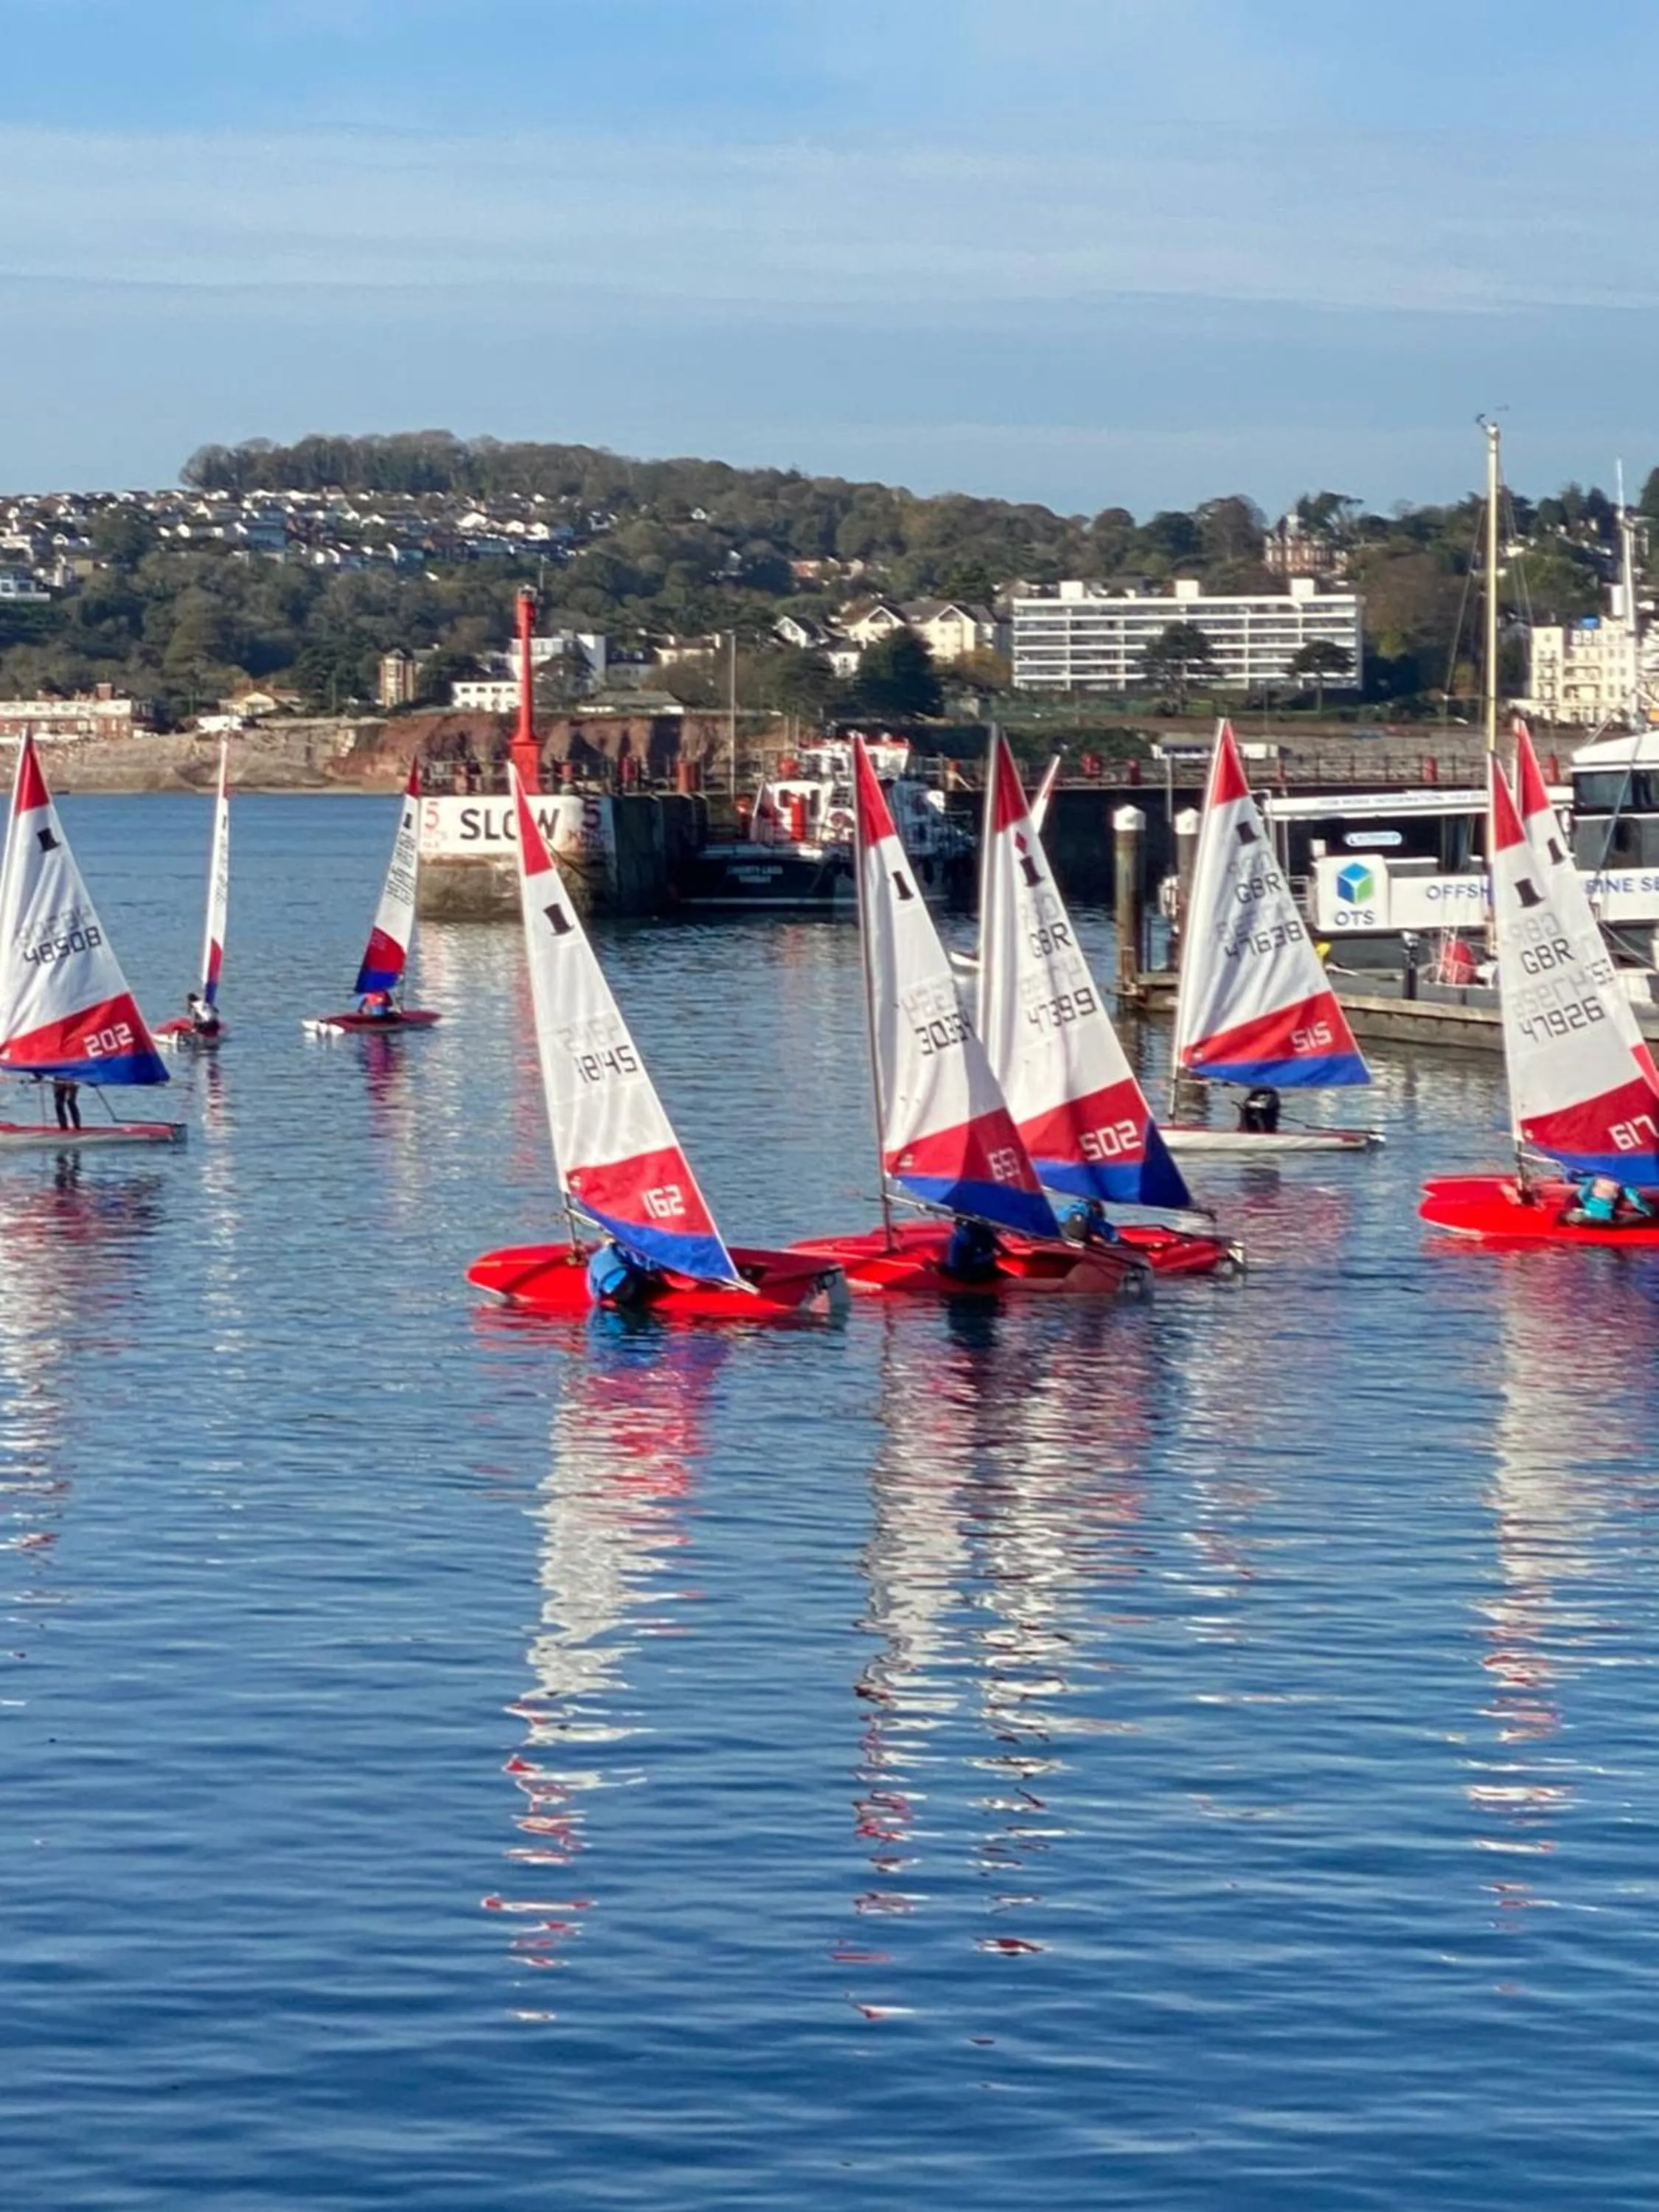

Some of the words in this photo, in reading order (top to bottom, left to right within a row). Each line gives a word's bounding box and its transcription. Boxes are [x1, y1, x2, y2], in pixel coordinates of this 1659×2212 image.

[460, 808, 560, 841] SLOW
[1234, 872, 1283, 904] GBR
[1426, 883, 1492, 901] OFFSH
[1334, 910, 1376, 927] OTS
[23, 925, 102, 966] 48508
[1029, 922, 1072, 959] GBR
[1225, 920, 1304, 961] 47638
[1520, 938, 1575, 975] GBR
[1290, 1021, 1334, 1054] 515
[1519, 995, 1606, 1043] 47926
[83, 1022, 136, 1057] 202
[1079, 1119, 1142, 1161] 502
[1607, 1113, 1659, 1151] 617
[641, 1183, 686, 1220] 162
